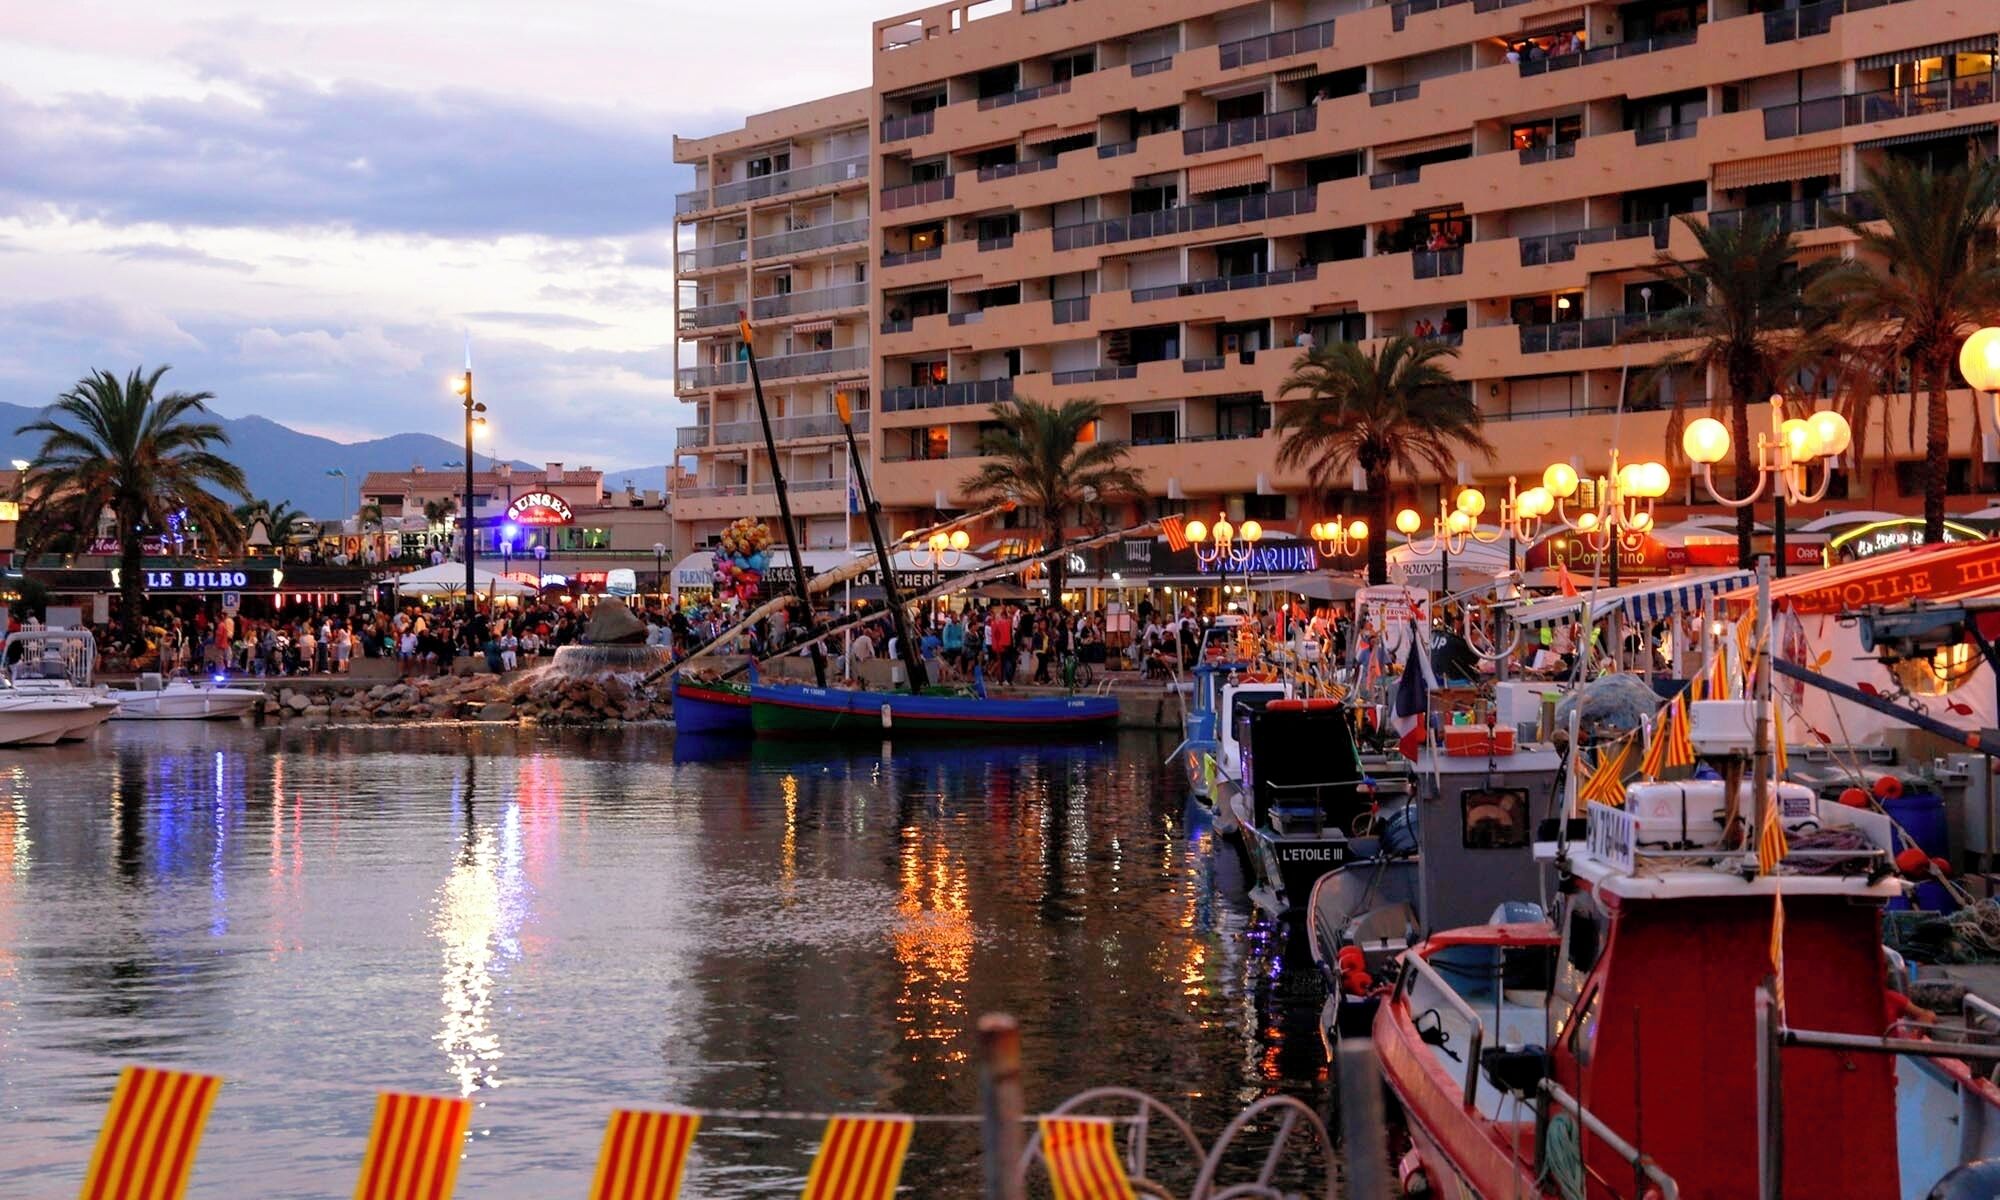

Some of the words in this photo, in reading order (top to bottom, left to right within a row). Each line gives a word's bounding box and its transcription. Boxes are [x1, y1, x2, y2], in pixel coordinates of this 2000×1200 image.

[508, 493, 572, 521] SUNSET
[1570, 539, 1645, 568] Portfino
[1402, 563, 1447, 575] BOUNT
[148, 572, 172, 587] LE
[184, 572, 247, 587] BILBO
[855, 574, 871, 586] LA
[875, 571, 945, 586] PCHERIE
[1282, 848, 1331, 861] L'ETOILE
[1333, 848, 1343, 860] III
